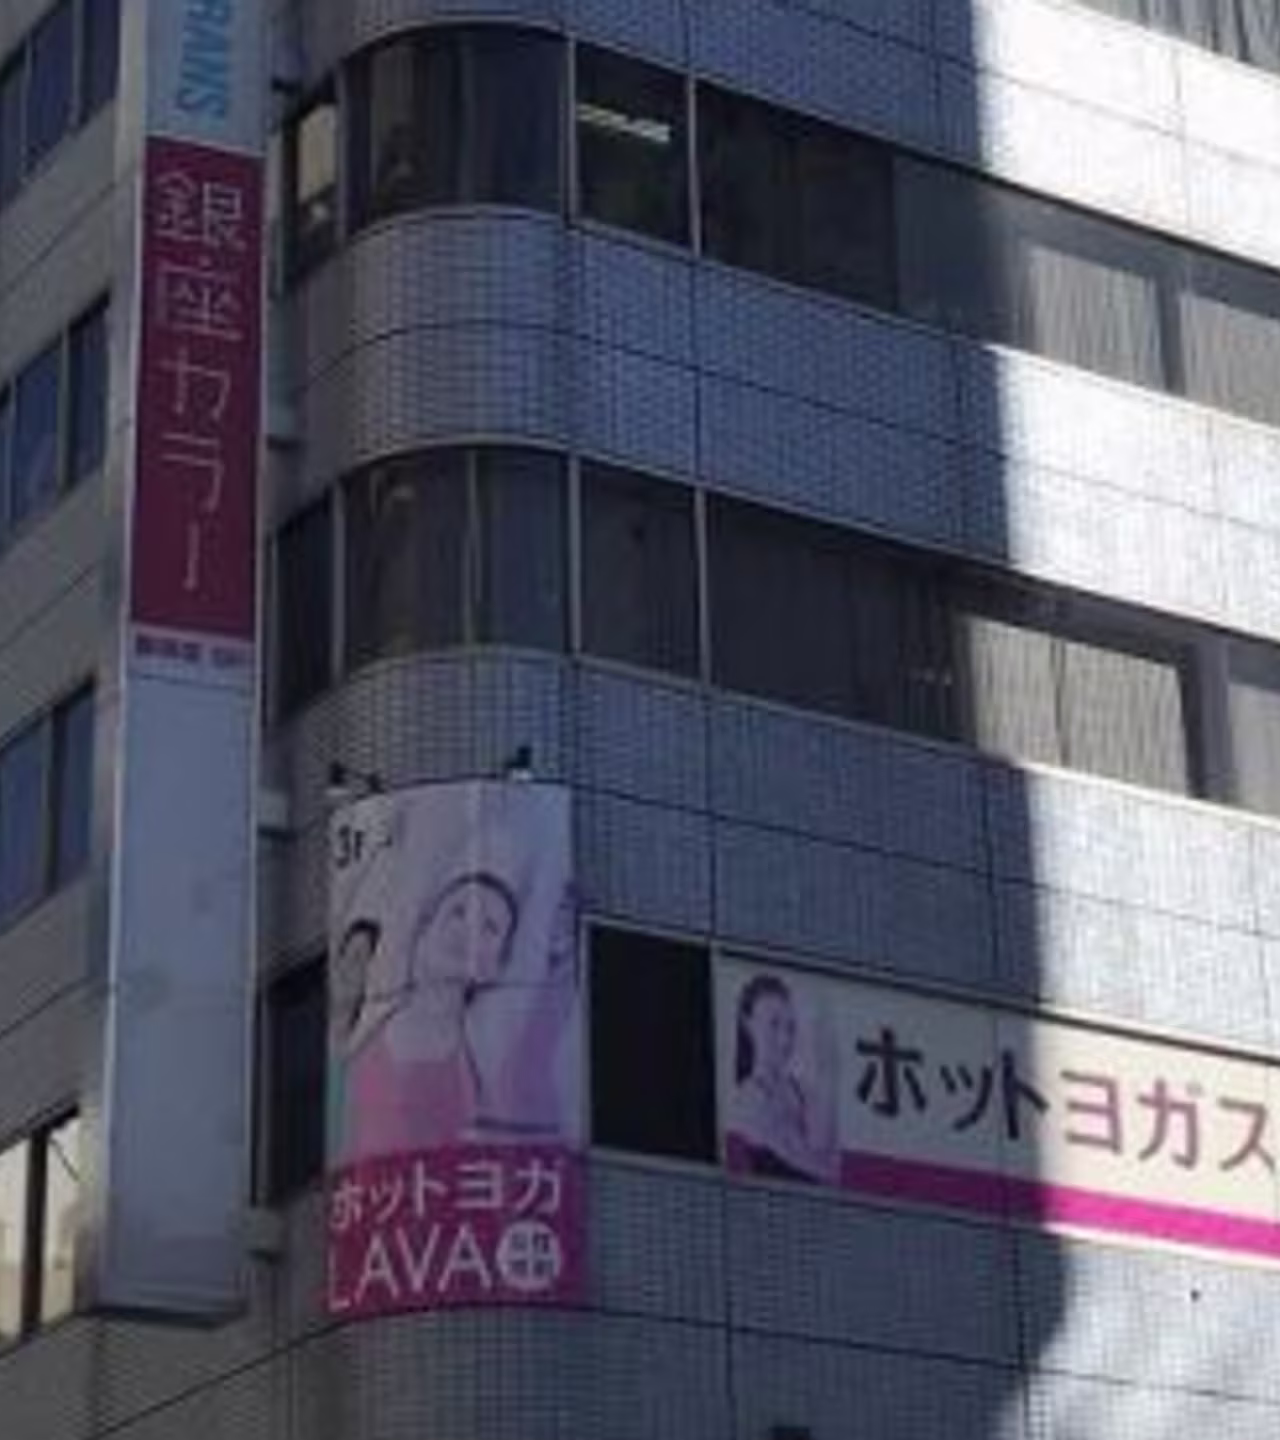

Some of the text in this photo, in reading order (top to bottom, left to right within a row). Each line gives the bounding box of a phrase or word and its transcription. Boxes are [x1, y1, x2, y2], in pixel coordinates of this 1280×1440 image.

[154, 170, 249, 591] 銀座カラー
[330, 1160, 562, 1230] ホットヨガ
[329, 1223, 493, 1311] LAVA
